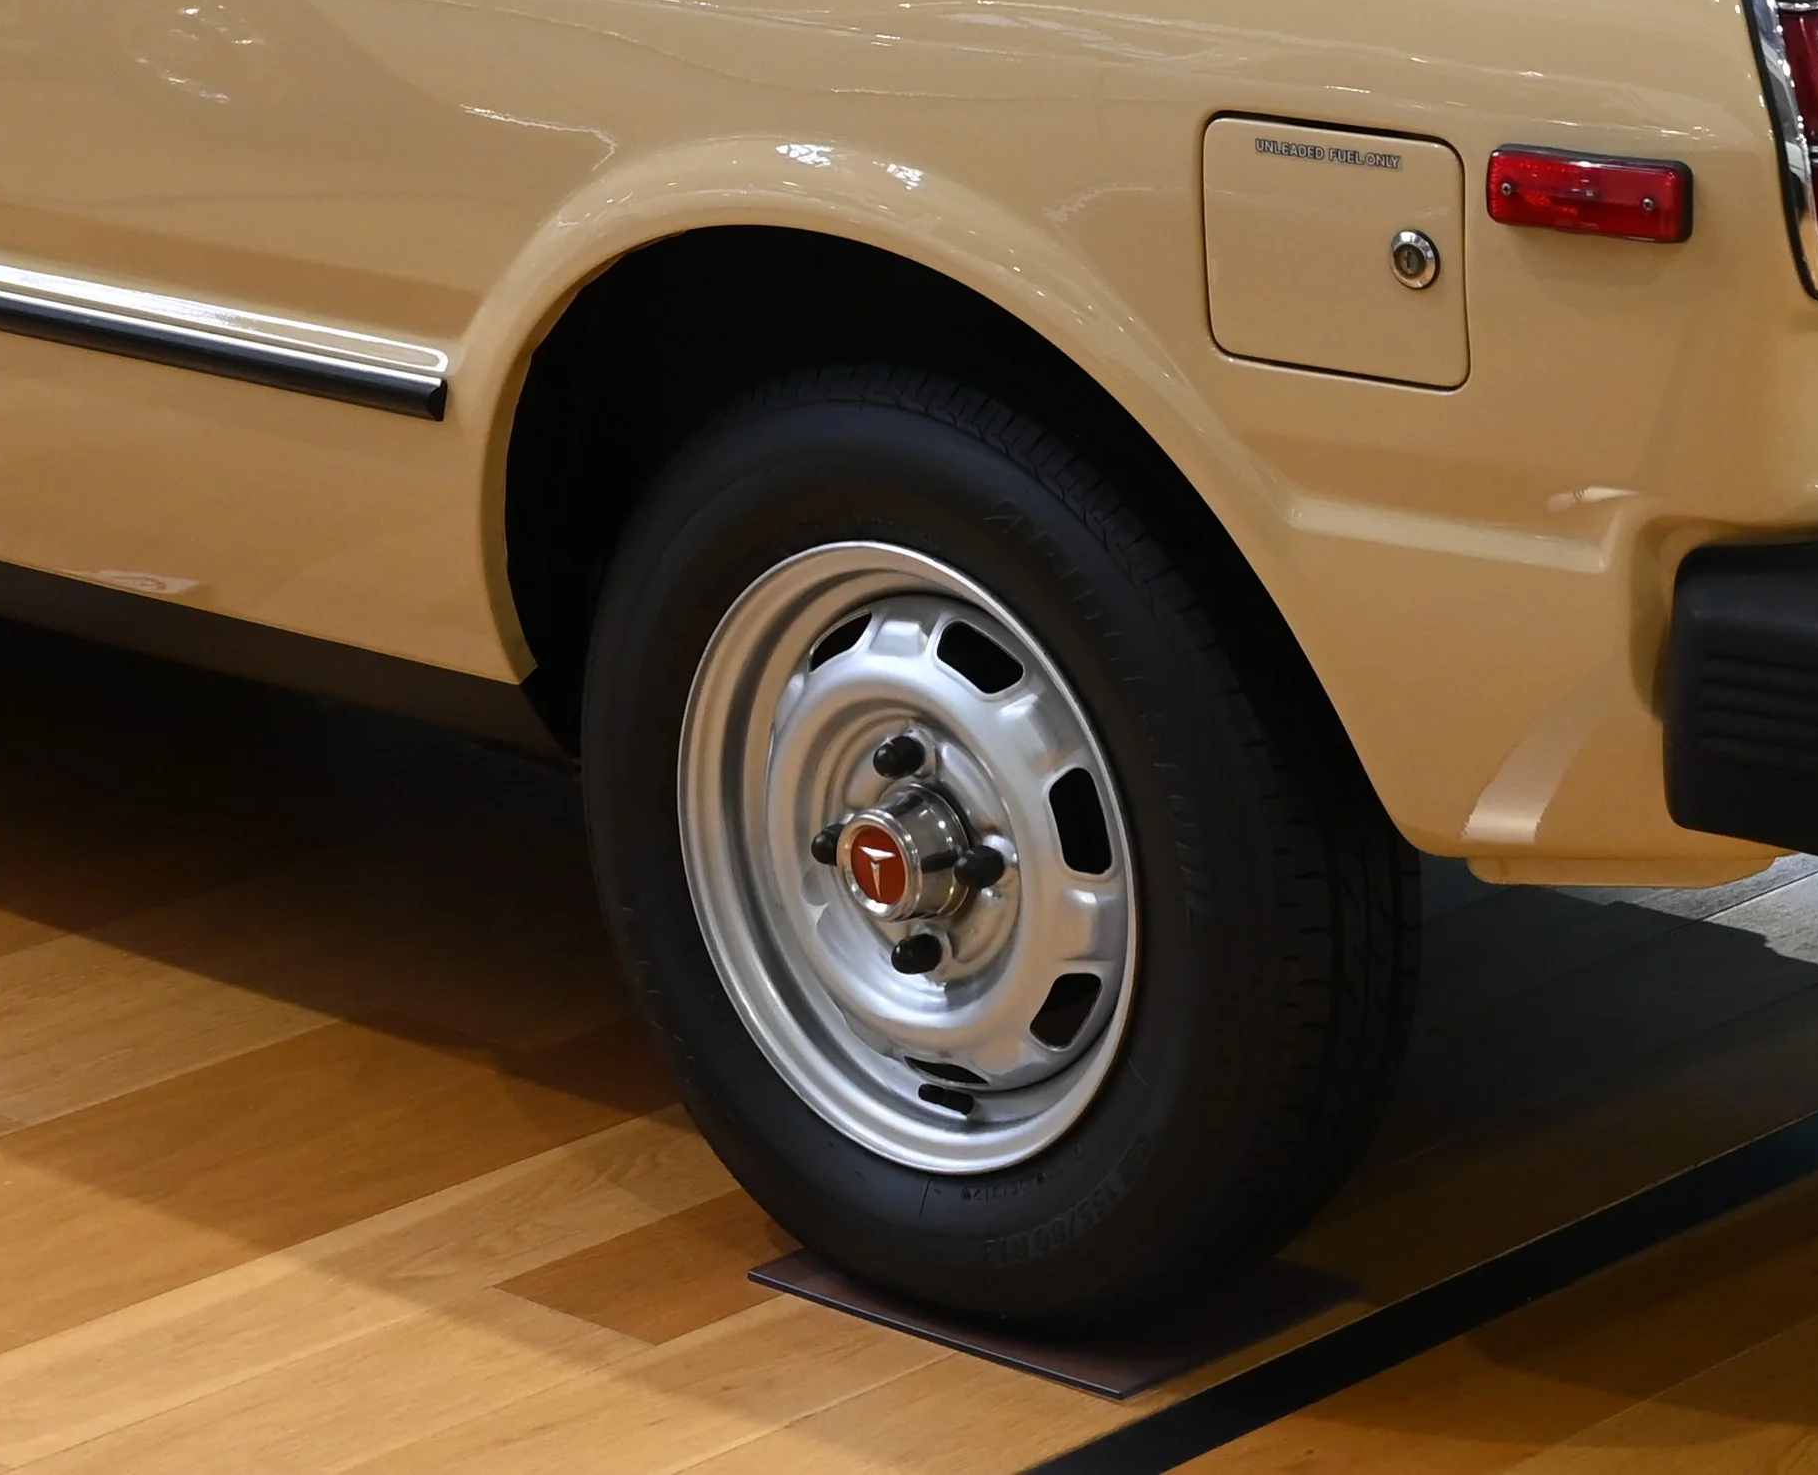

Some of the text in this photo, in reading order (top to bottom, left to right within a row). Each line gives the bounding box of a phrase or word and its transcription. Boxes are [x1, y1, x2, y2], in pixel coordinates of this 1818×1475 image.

[1254, 137, 1402, 169] UNLEADED FUEL ONLY
